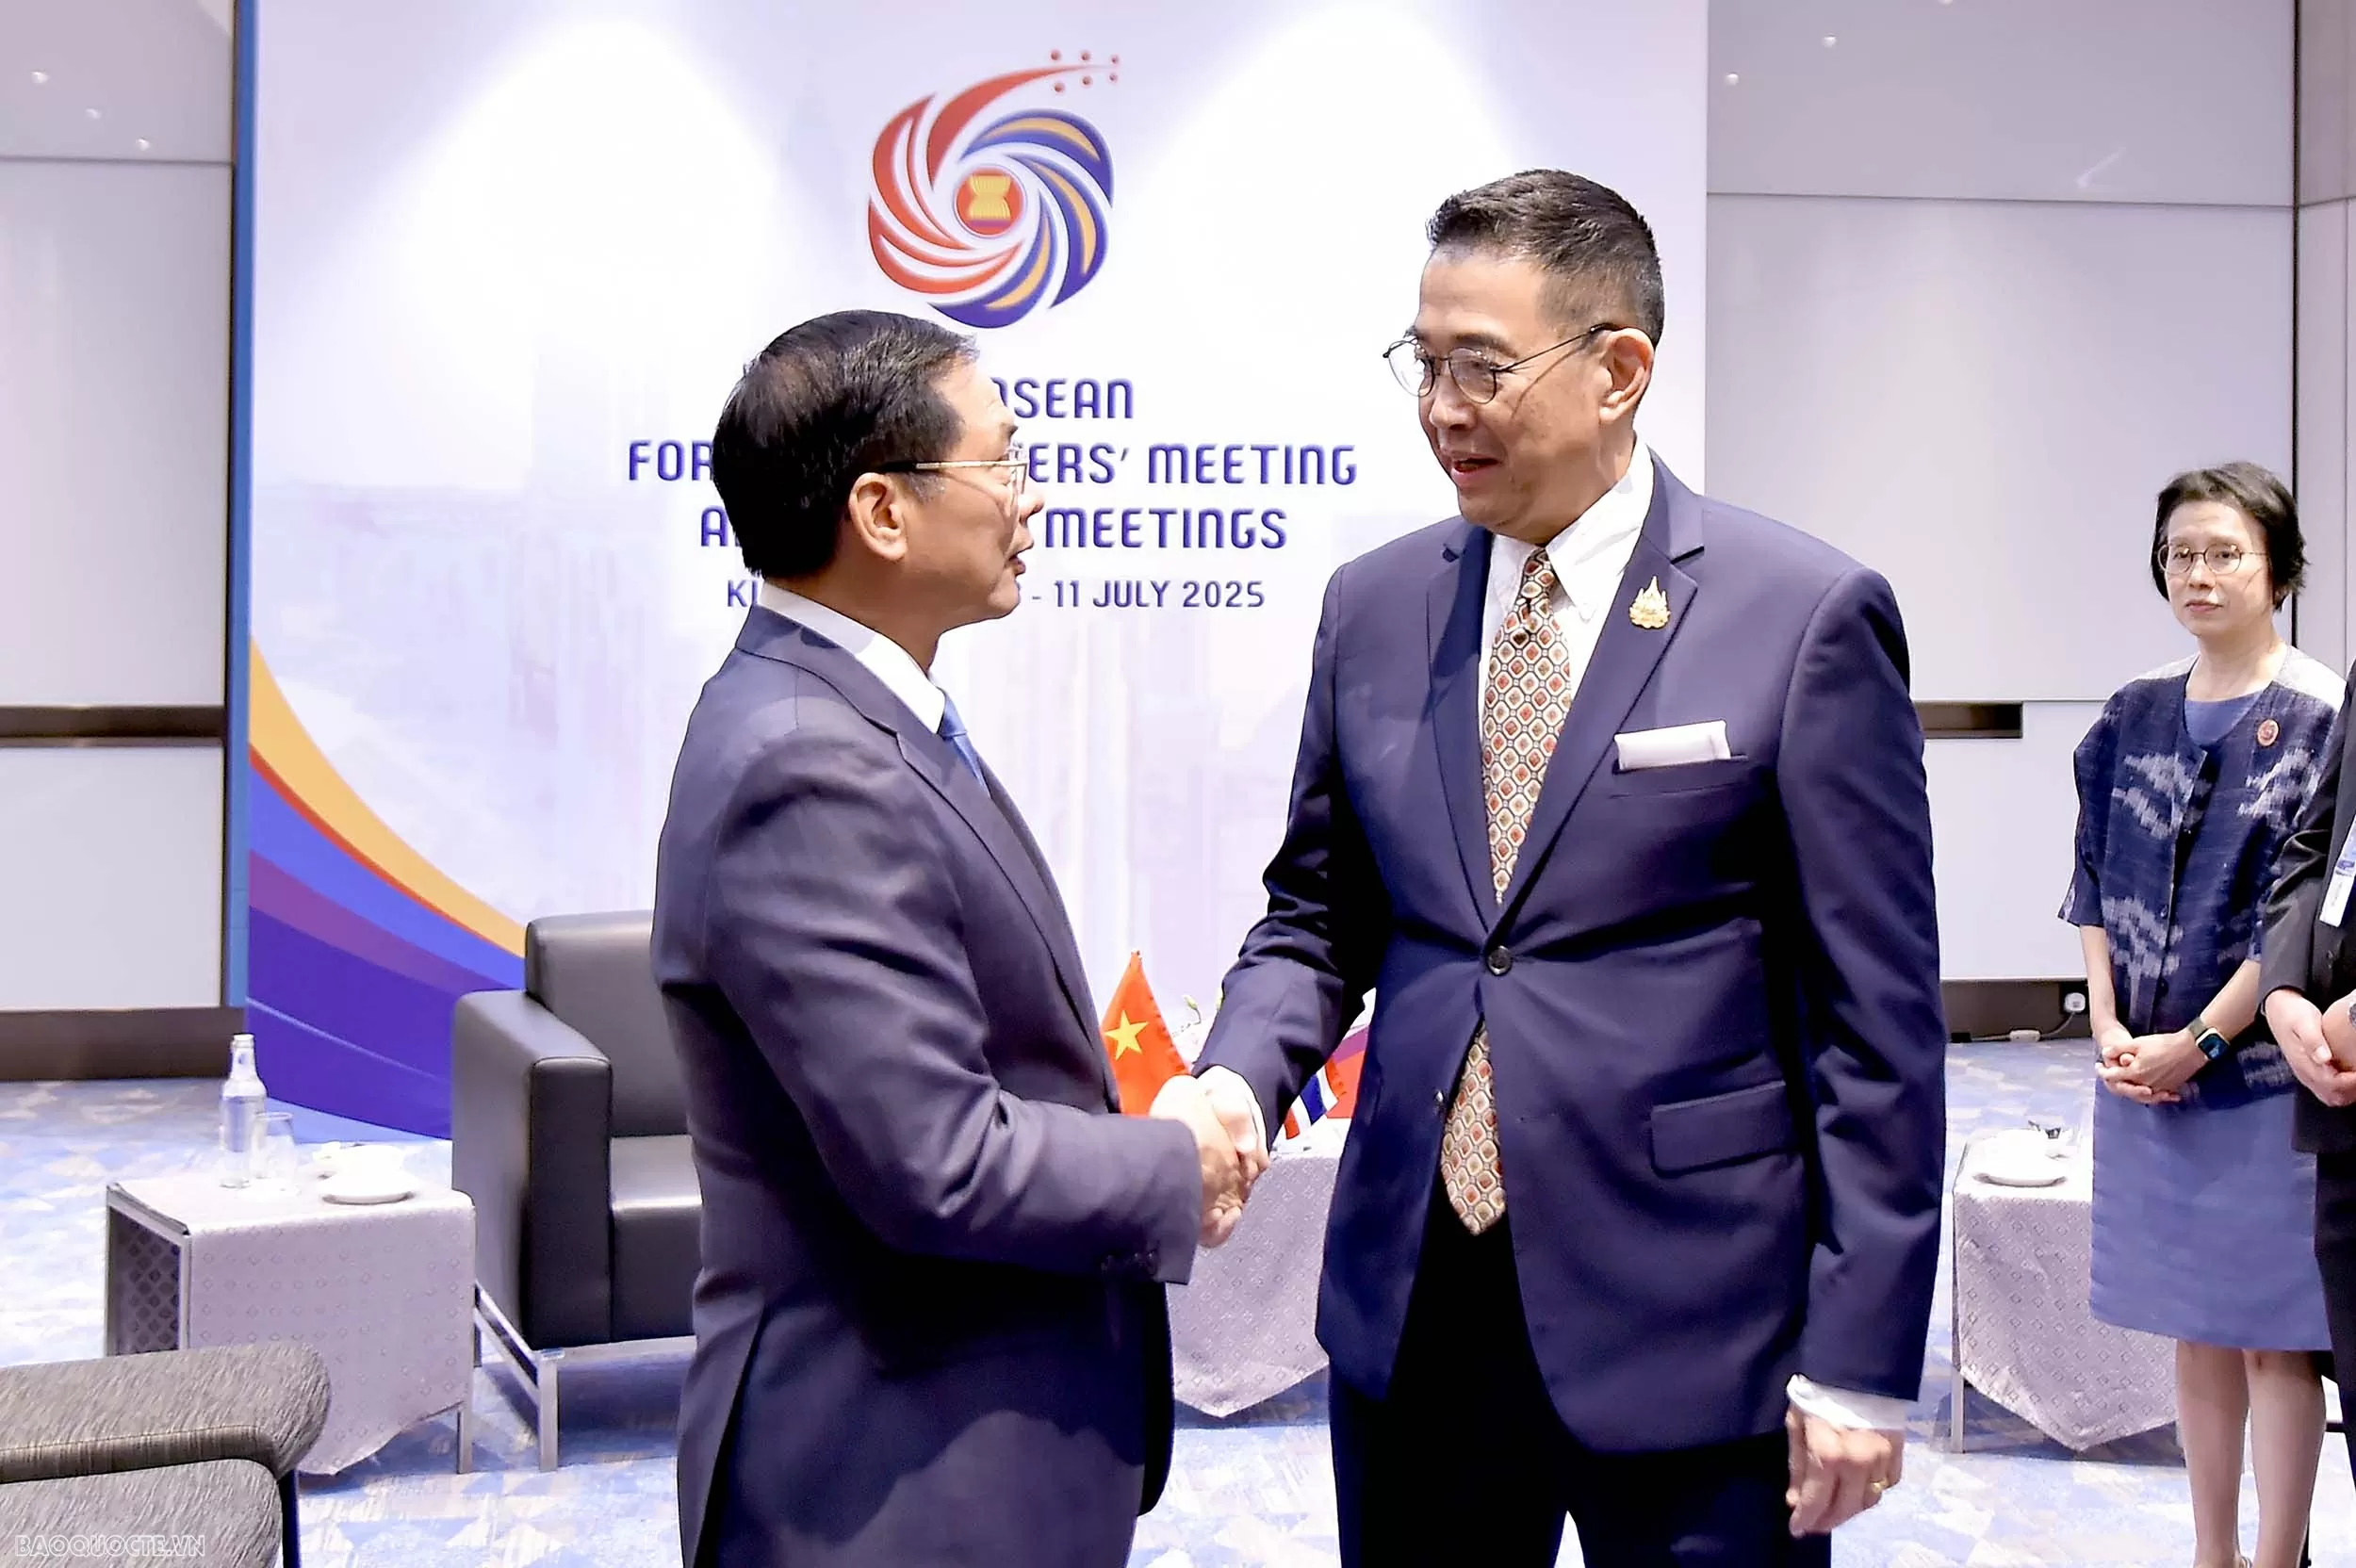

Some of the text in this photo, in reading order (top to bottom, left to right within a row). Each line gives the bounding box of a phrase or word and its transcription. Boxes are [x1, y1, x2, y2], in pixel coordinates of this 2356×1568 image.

[1148, 443, 1357, 485] MEETING
[1044, 507, 1287, 549] MEETINGS
[1054, 580, 1079, 608] 11
[1092, 580, 1170, 608] JULY
[1182, 580, 1265, 608] 2025
